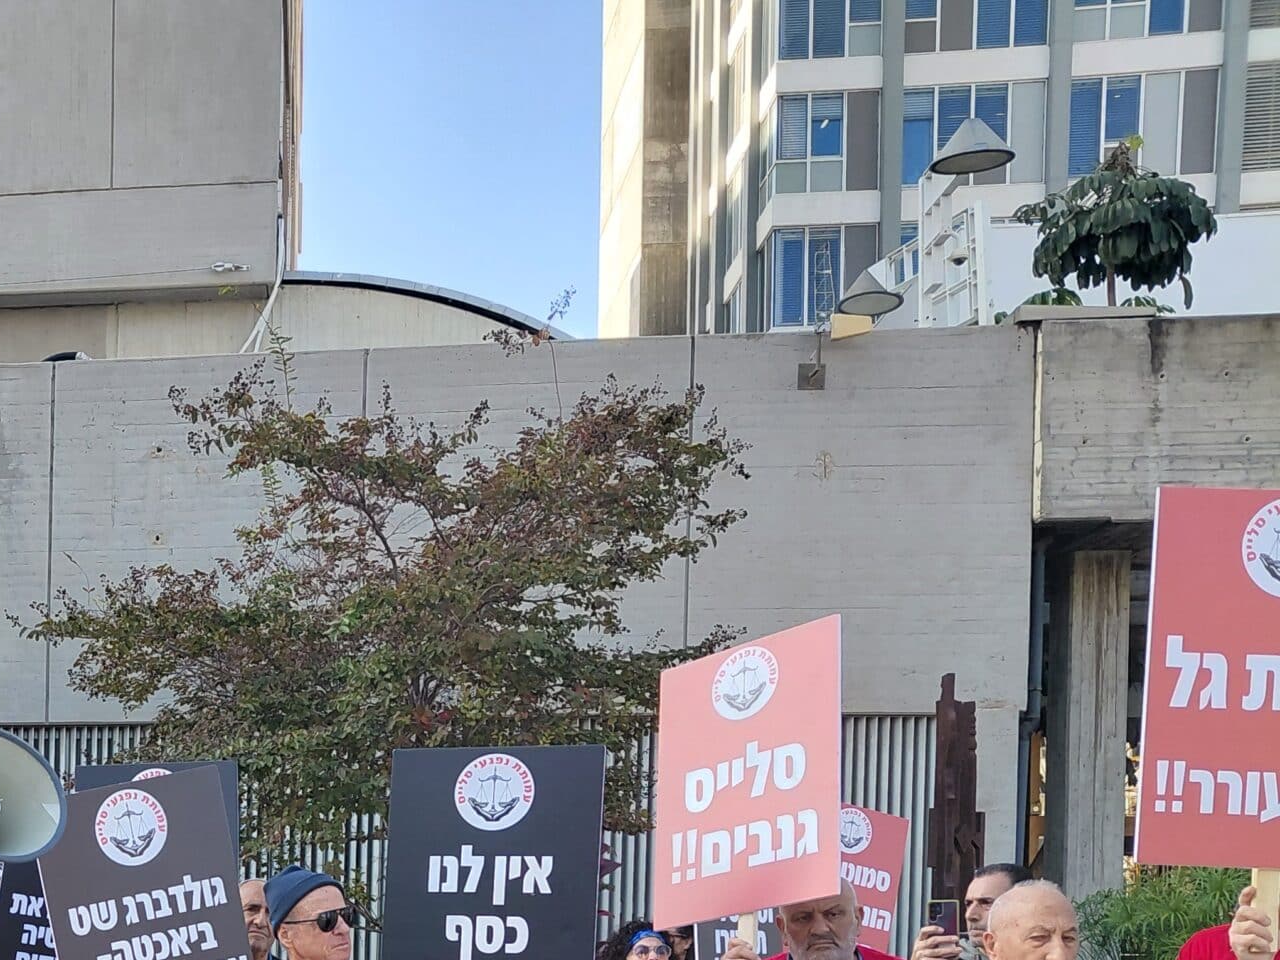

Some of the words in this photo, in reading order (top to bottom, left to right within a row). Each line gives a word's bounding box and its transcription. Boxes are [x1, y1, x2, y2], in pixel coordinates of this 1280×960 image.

[1246, 517, 1266, 562] סלייס
[1166, 634, 1228, 711] גל
[1241, 654, 1280, 711] ת
[474, 756, 510, 768] נפגעי
[512, 762, 532, 803] עמותת
[685, 740, 807, 813] סלייס
[107, 792, 138, 807] נפגעי
[458, 770, 473, 804] סלייס
[97, 810, 108, 846] סלייס
[141, 794, 165, 832] עמותת
[671, 808, 819, 885] גנבים!!
[427, 844, 485, 893] לנו
[493, 855, 553, 905] אין
[10, 893, 44, 918] את
[68, 899, 118, 936] שט
[122, 874, 228, 926] גולדברג
